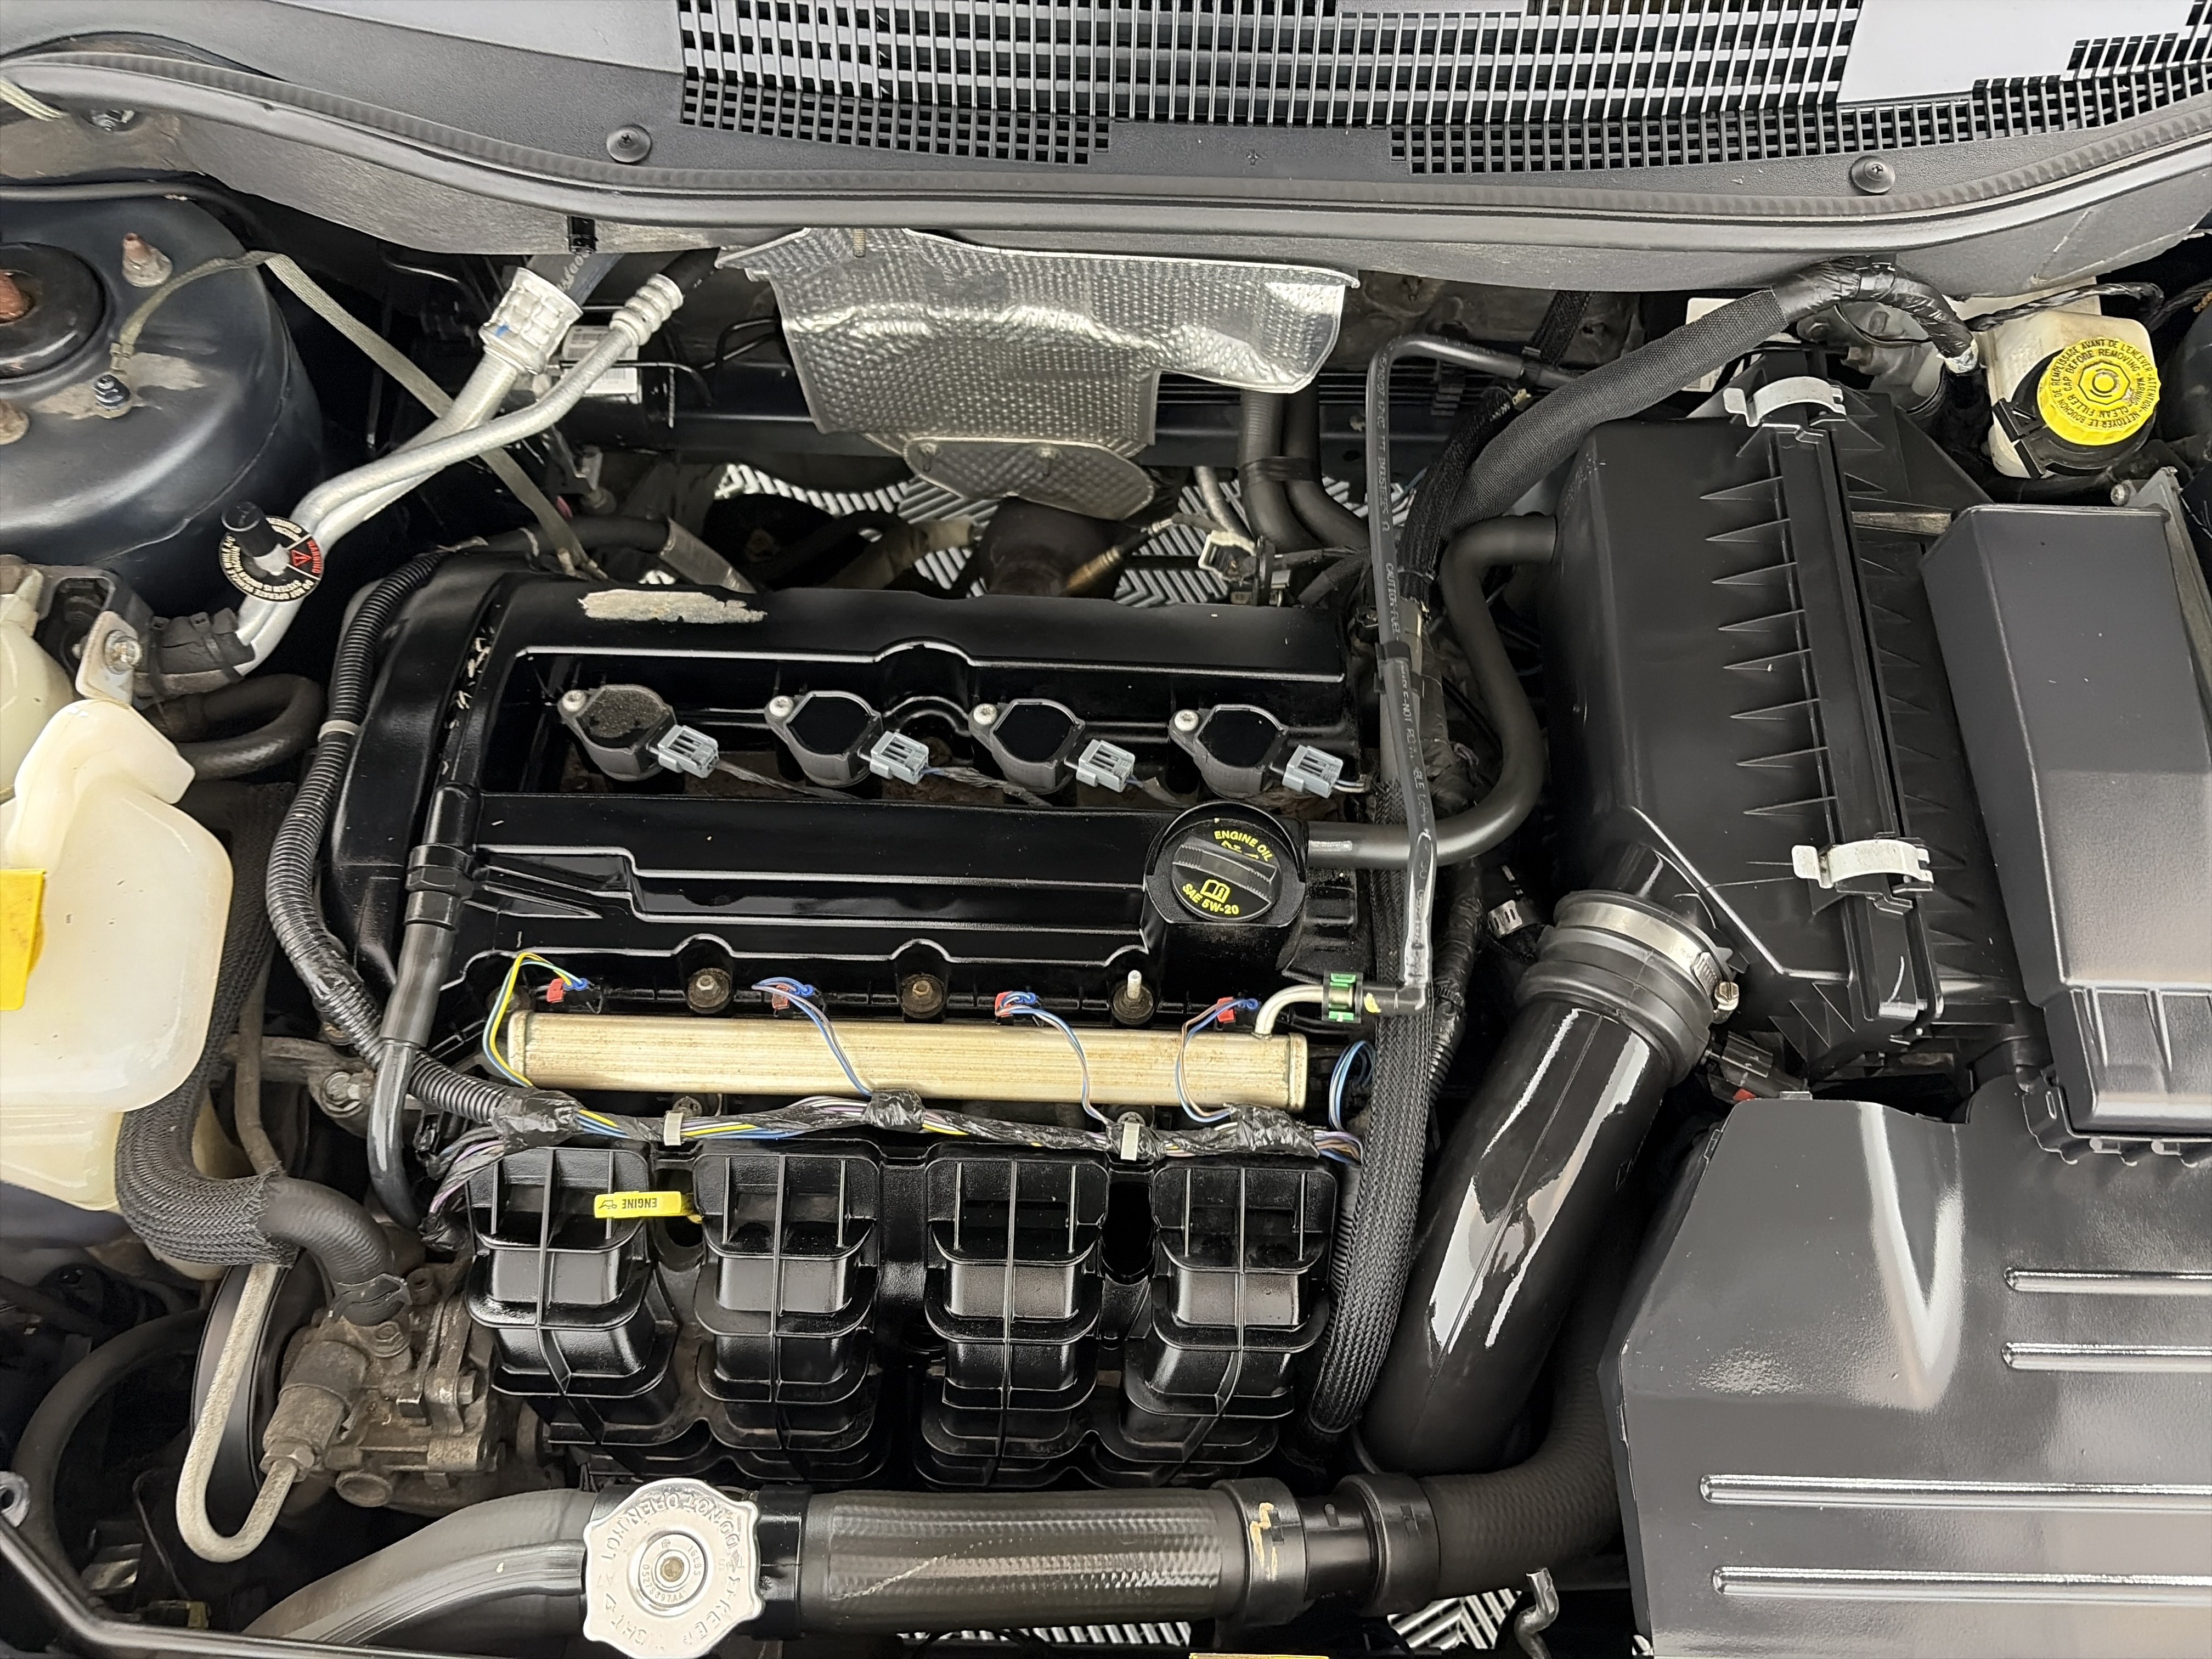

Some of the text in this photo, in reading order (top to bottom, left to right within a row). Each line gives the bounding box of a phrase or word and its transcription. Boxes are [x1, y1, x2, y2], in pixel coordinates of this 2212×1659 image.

[2081, 339, 2105, 351] AVANT
[2108, 340, 2119, 348] DE
[2051, 346, 2079, 386] REMPLISSAGE
[2098, 348, 2140, 372] REMOVING
[2052, 388, 2063, 398] DE
[2063, 376, 2129, 419] CLEAN FILLER CAP
[2089, 419, 2098, 427] LE
[2102, 411, 2140, 428] NETTOYER
[230, 545, 244, 572] VACUUM
[302, 579, 315, 591] DO
[1214, 830, 1273, 862] ENGINE OIL
[1182, 883, 1239, 915] SAE 5W-20
[622, 1198, 658, 1209] ENGINE
